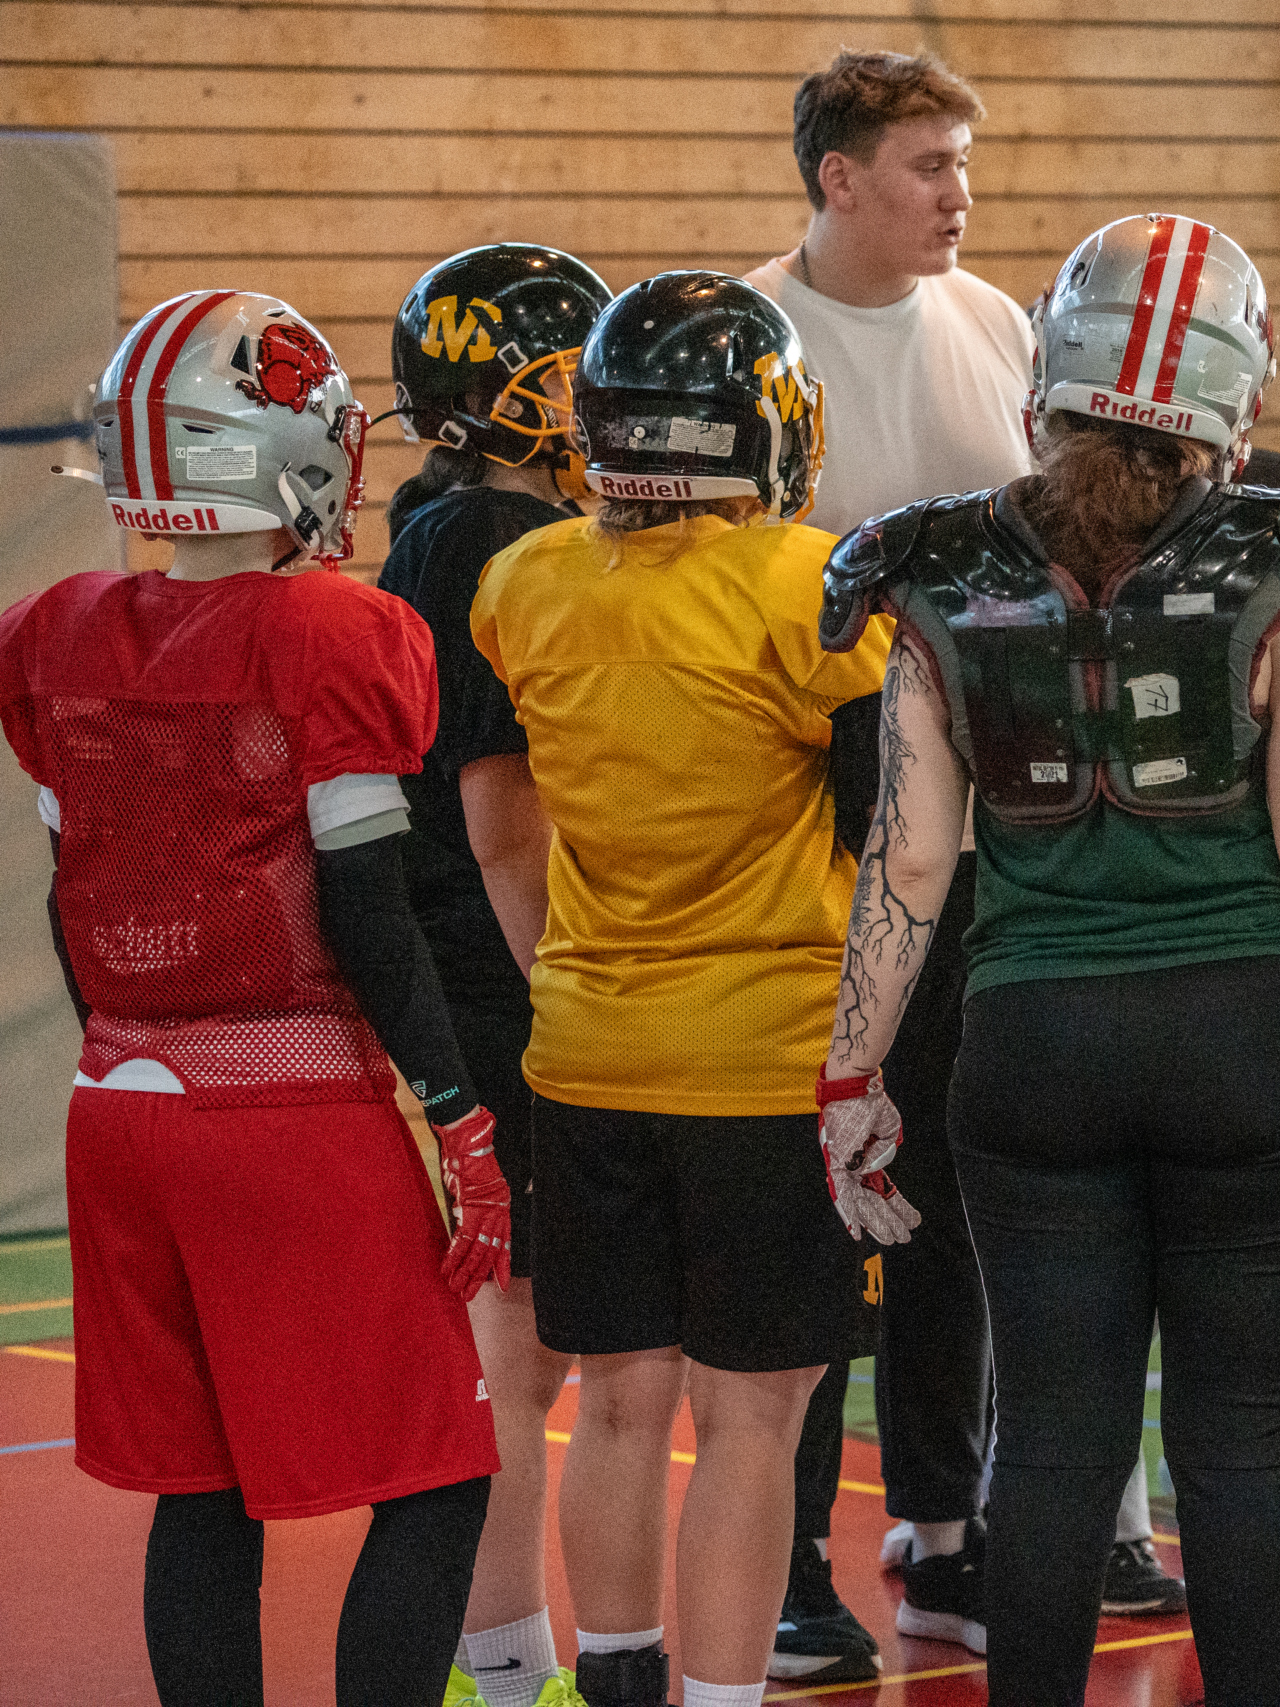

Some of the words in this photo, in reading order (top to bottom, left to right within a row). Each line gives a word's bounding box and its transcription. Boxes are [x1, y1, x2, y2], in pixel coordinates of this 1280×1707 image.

[1089, 392, 1193, 432] Riddell
[601, 476, 693, 499] Riddell
[111, 503, 220, 532] Riddell
